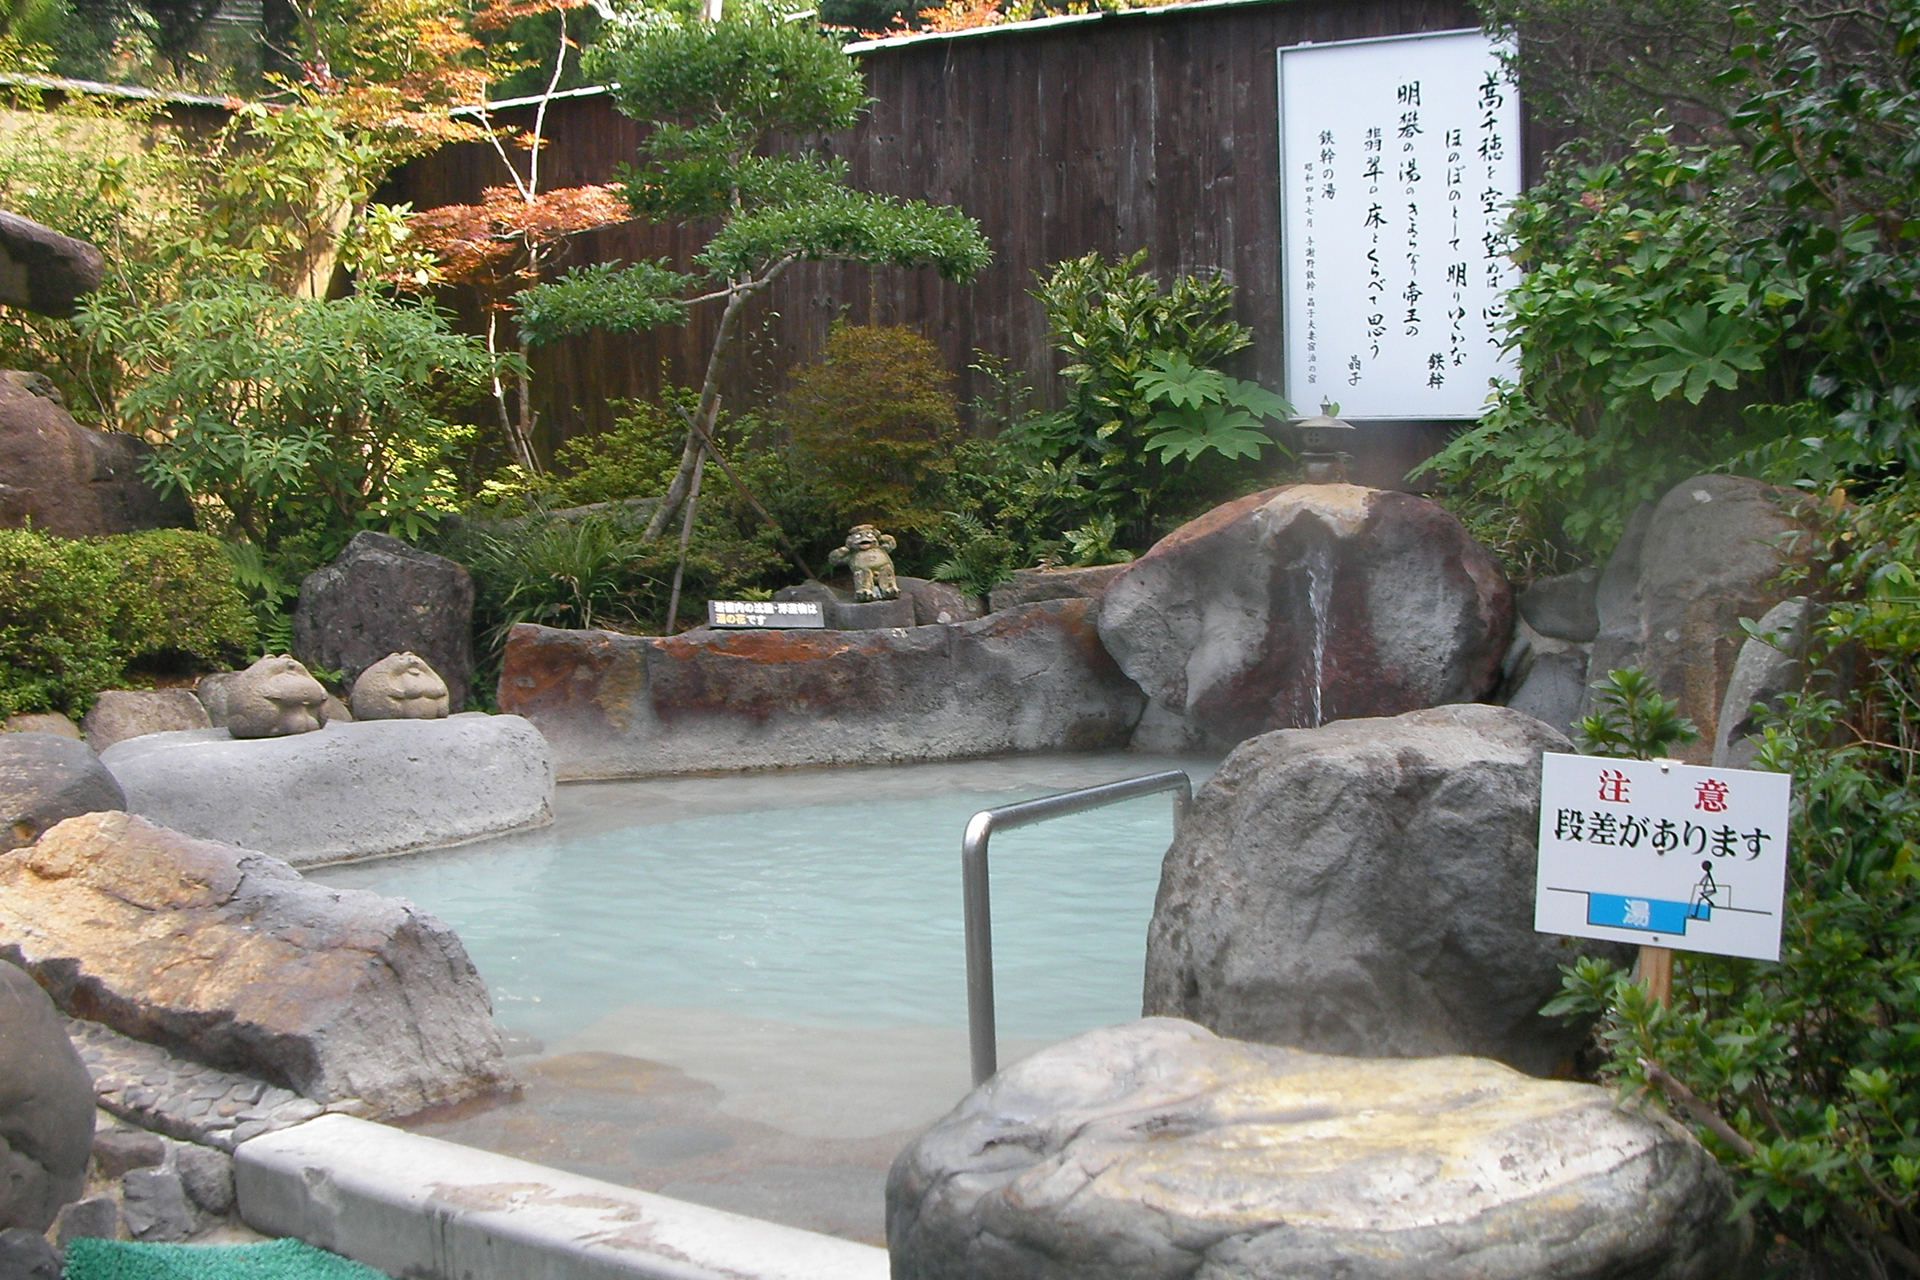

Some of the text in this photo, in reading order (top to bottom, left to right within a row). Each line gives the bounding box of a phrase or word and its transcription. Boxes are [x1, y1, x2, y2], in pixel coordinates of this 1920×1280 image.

[1319, 129, 1336, 200] 鉄幹の湯
[1348, 355, 1362, 386] 晶子
[1427, 352, 1445, 390] 鉄幹
[1554, 807, 1771, 860] 段差があります
[1623, 898, 1650, 927] 湯
